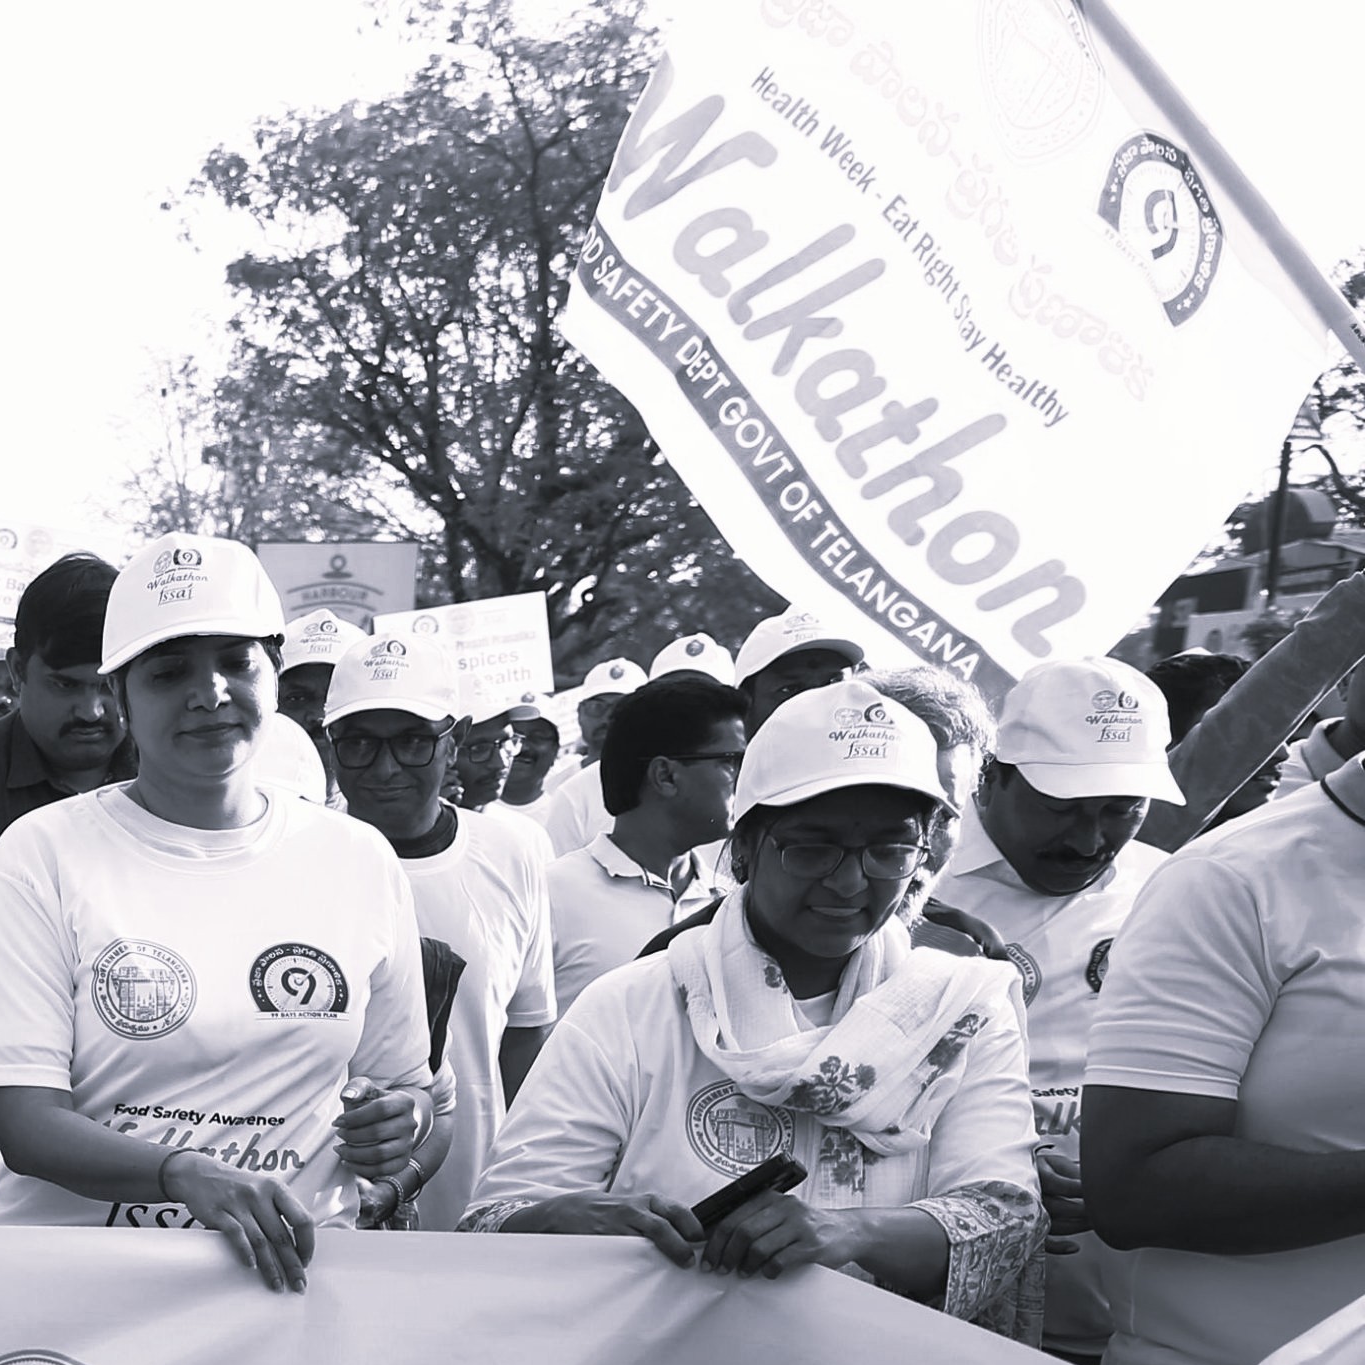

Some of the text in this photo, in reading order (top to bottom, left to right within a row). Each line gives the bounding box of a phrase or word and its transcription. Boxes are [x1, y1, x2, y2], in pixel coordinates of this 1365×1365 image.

[751, 66, 1070, 428] Health Week Eat Right Stay Healthy
[608, 53, 1087, 657] Walkathon
[593, 254, 981, 682] SAFETY DEPT GOVT OF TELANGANA
[146, 574, 209, 591] Walkathon
[157, 584, 194, 606] fssai
[457, 650, 519, 671] spices
[1085, 714, 1142, 726] Walkathon
[1032, 1087, 1080, 1098] Safety
